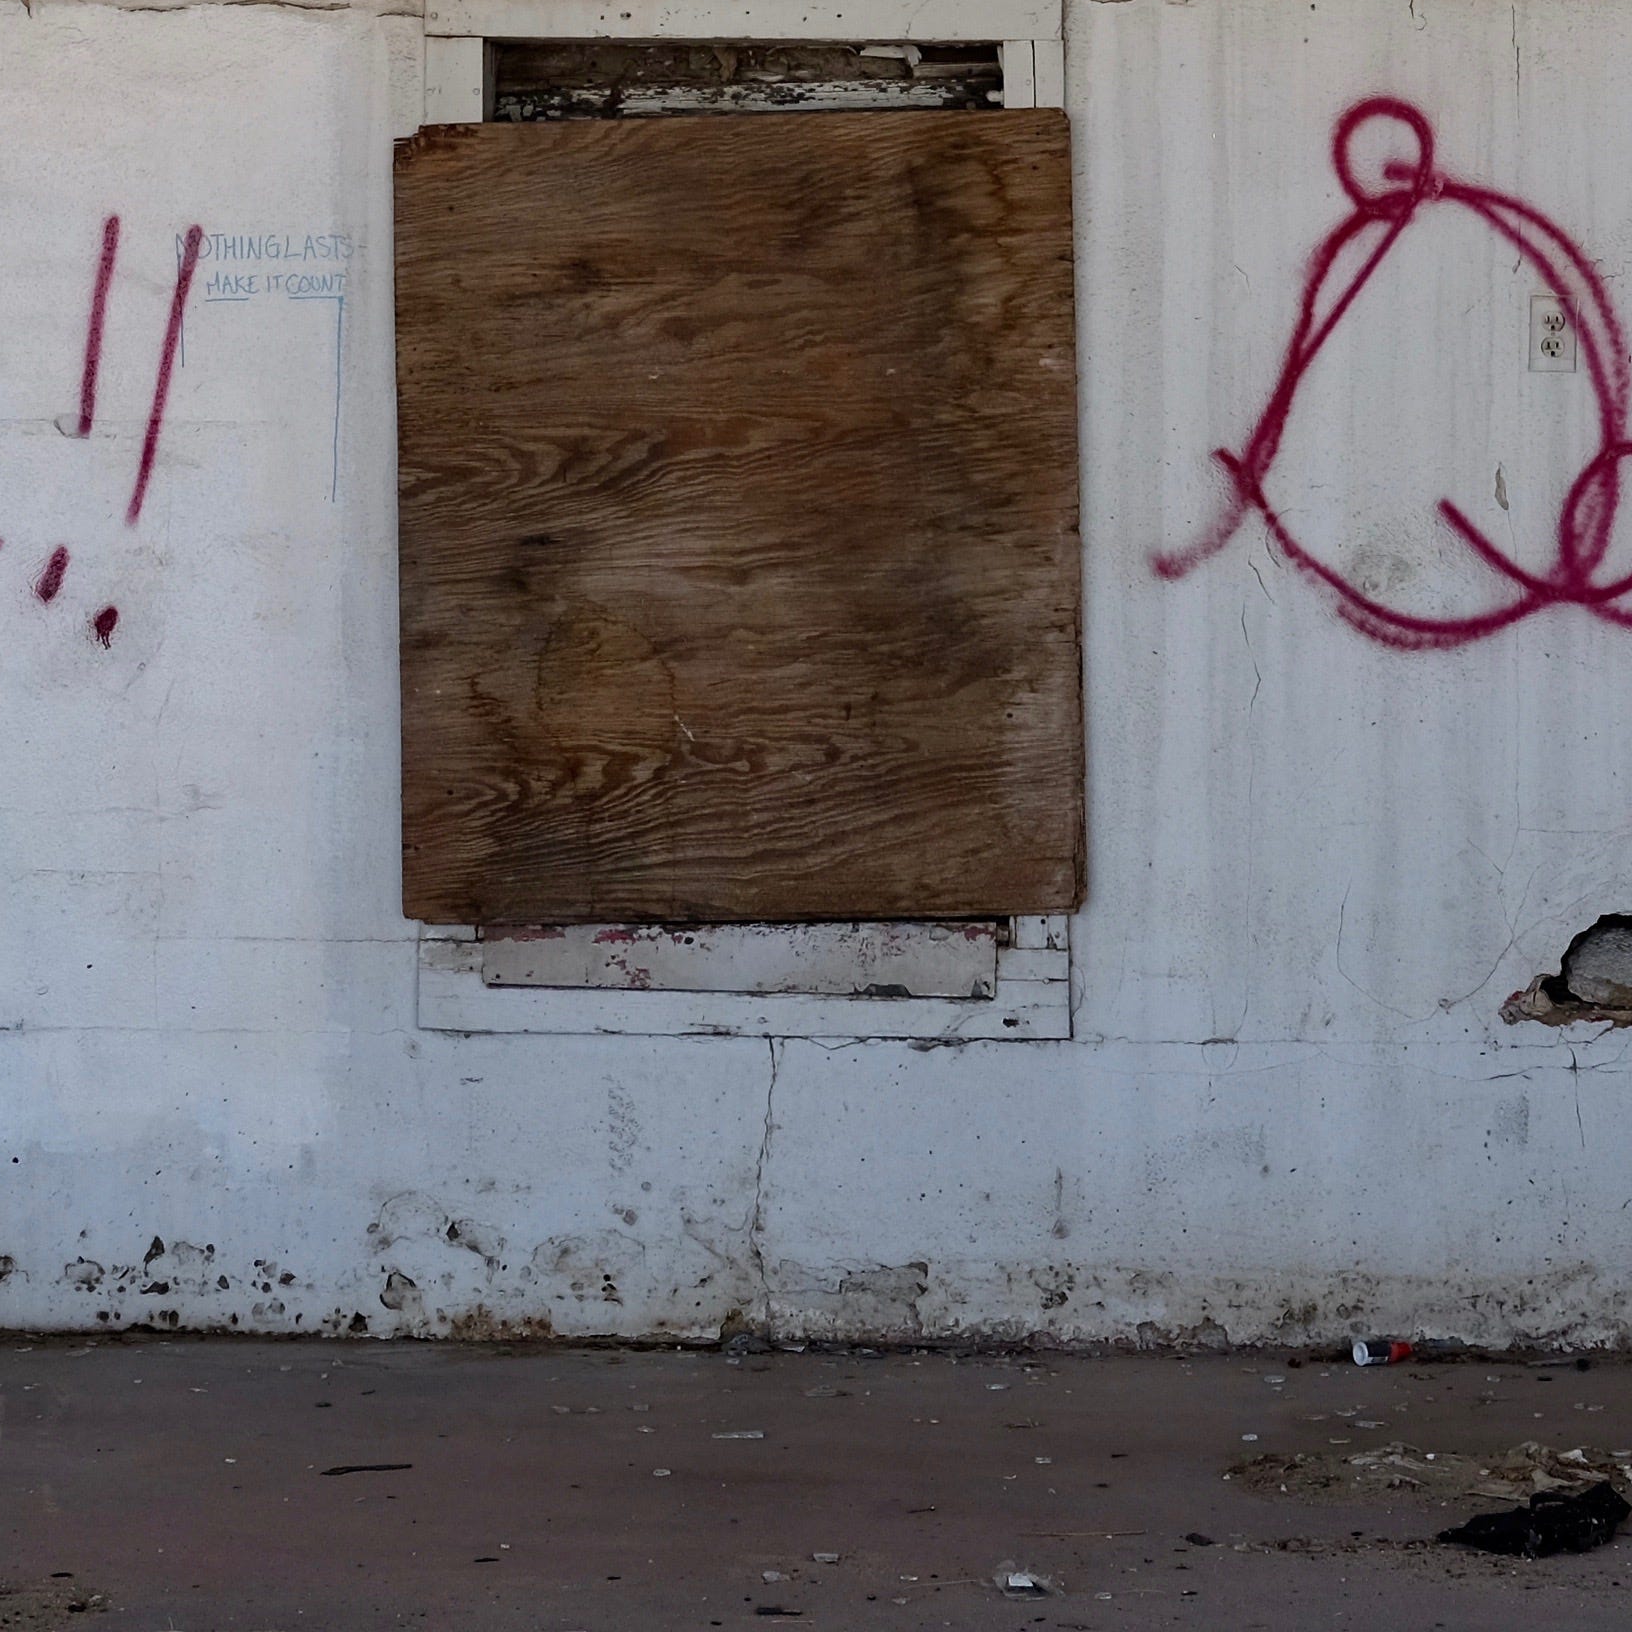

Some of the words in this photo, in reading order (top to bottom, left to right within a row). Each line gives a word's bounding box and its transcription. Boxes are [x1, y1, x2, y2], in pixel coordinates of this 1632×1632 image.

[205, 271, 260, 296] MAKE
[266, 274, 284, 293] IT
[284, 273, 347, 295] COUNT
